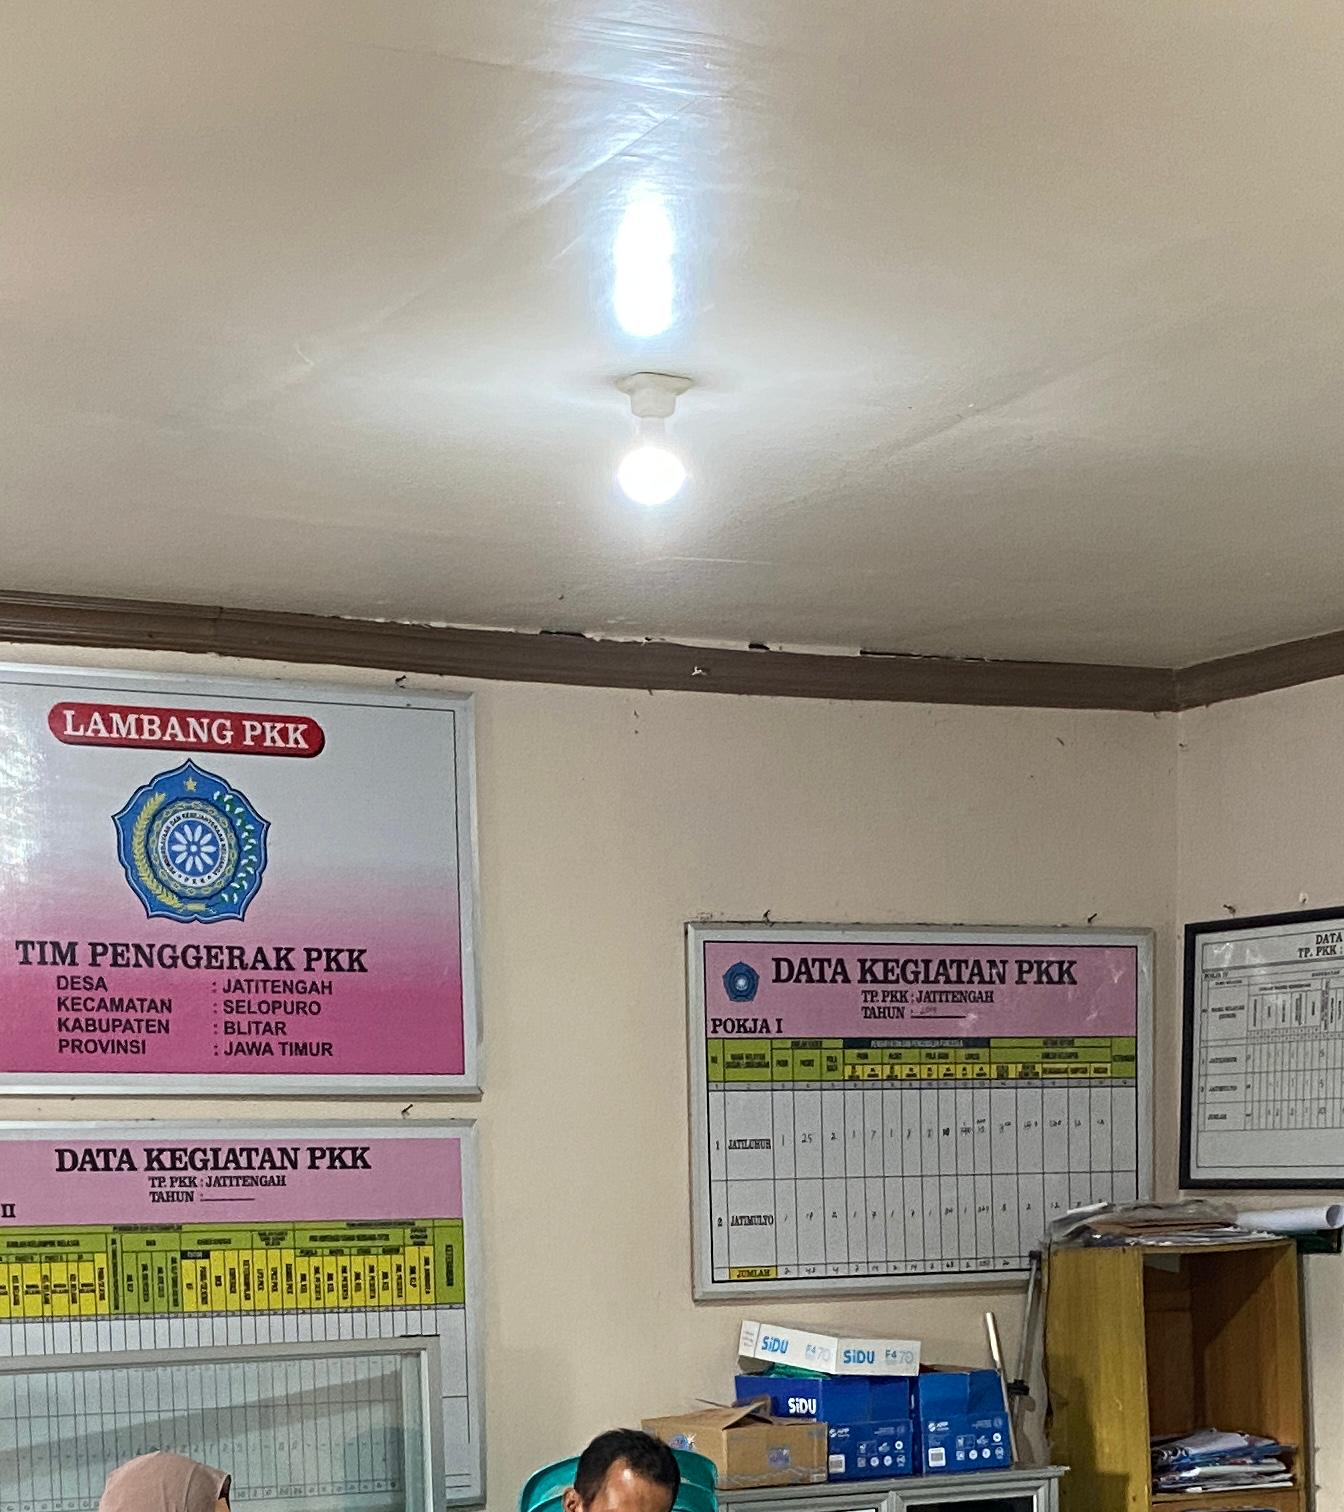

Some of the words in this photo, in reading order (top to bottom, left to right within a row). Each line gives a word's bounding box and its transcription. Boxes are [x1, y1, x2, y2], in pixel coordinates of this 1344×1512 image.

[62, 709, 234, 745] LAMBANG
[241, 719, 309, 749] PKK
[1315, 931, 1343, 945] DATA
[15, 939, 78, 966] TIM
[87, 941, 296, 970] PENGGERAK
[303, 947, 369, 973] PKK
[1316, 944, 1337, 957] PKK
[771, 956, 852, 984] DATA
[857, 958, 1008, 985] KEGIATAN
[1014, 959, 1078, 985] PKK
[56, 975, 109, 992] DESA
[222, 978, 334, 995] JATITENGAH
[861, 989, 880, 1004] TP.
[881, 989, 909, 1004] PKK
[916, 989, 994, 1004] JATITENGAH
[57, 996, 173, 1013] KECAMATAN
[222, 999, 322, 1016] SELOPURO
[861, 1005, 905, 1019] TAHUN
[57, 1017, 171, 1034] KABUPATEN
[223, 1020, 288, 1036] BLITAR
[710, 1017, 772, 1034] POKJA
[775, 1018, 783, 1034] I
[58, 1038, 147, 1055] PROVINSI
[223, 1040, 274, 1056] JAWA
[278, 1041, 334, 1057] TIMUR
[54, 1147, 138, 1173] DATA
[143, 1147, 301, 1173] KEGIATAN
[306, 1145, 373, 1170] PKK
[148, 1175, 167, 1189] TP.
[169, 1175, 198, 1188] PKK
[204, 1174, 287, 1188] JATITENGAH
[149, 1191, 195, 1203] TAHUN
[1, 1202, 17, 1219] II
[787, 1397, 817, 1414] SiDU
